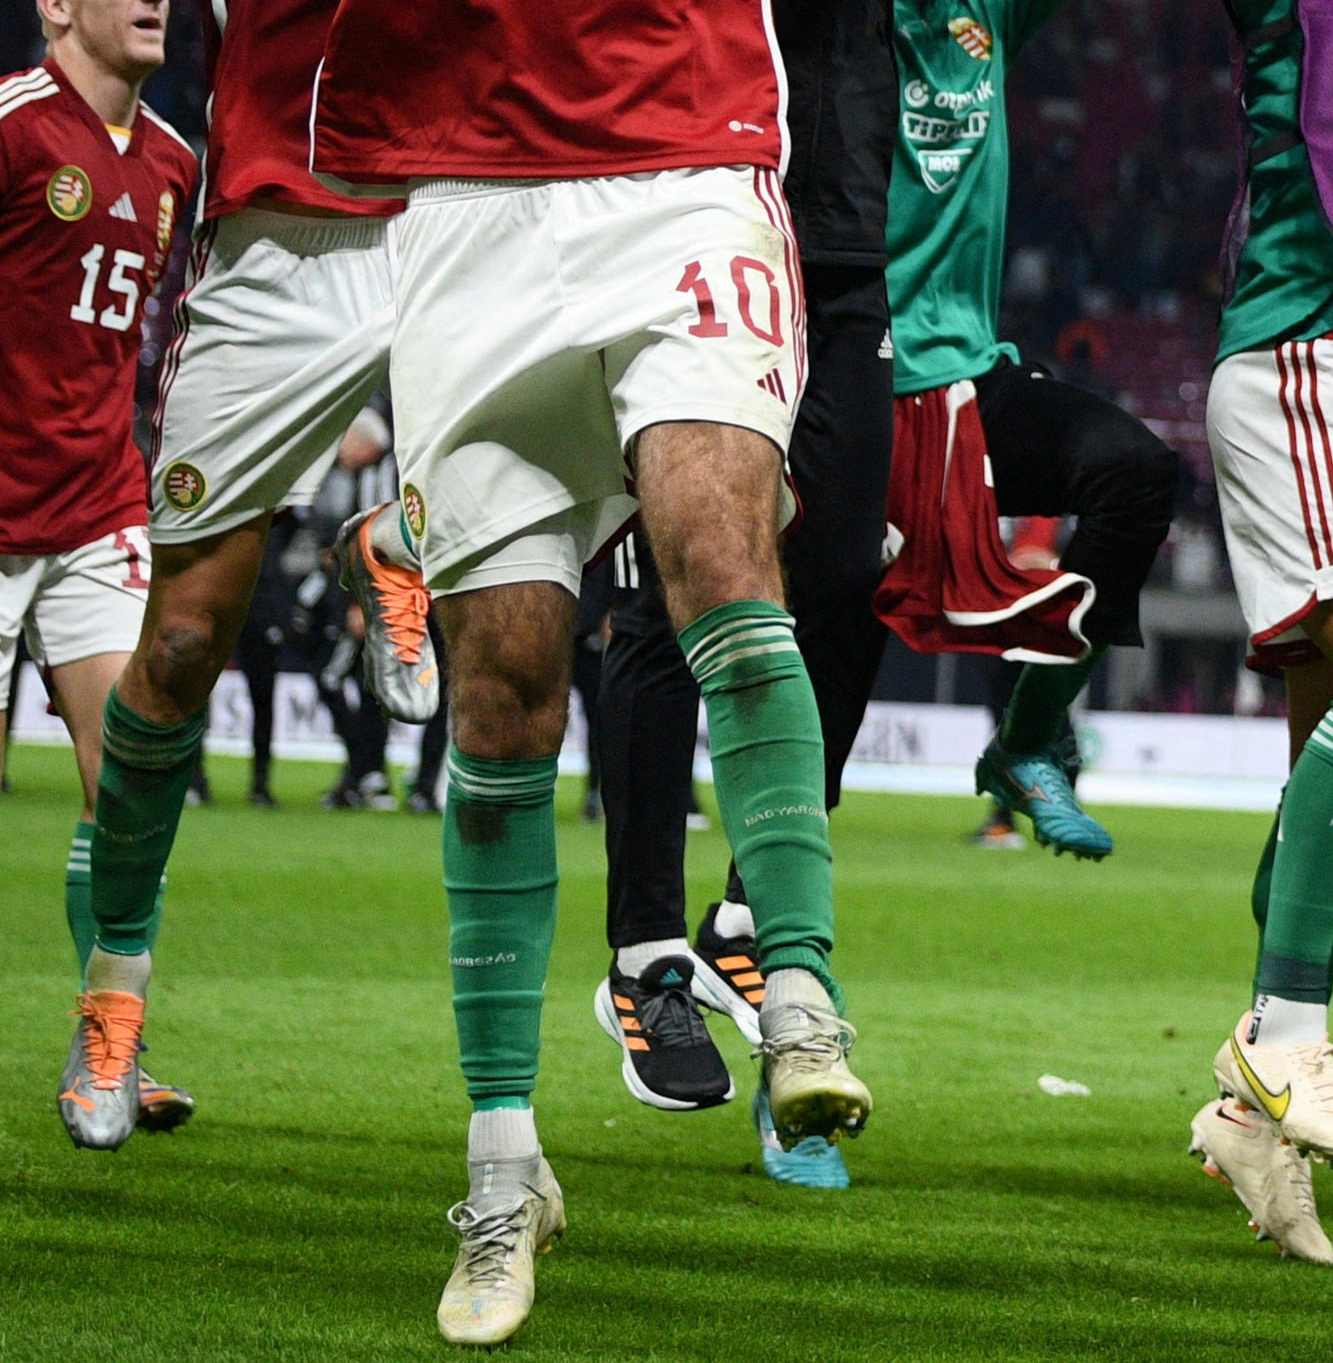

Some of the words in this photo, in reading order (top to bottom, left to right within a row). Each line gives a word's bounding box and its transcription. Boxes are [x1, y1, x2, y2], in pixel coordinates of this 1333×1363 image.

[69, 243, 145, 331] 15
[676, 255, 784, 348] 10
[113, 531, 150, 589] 1
